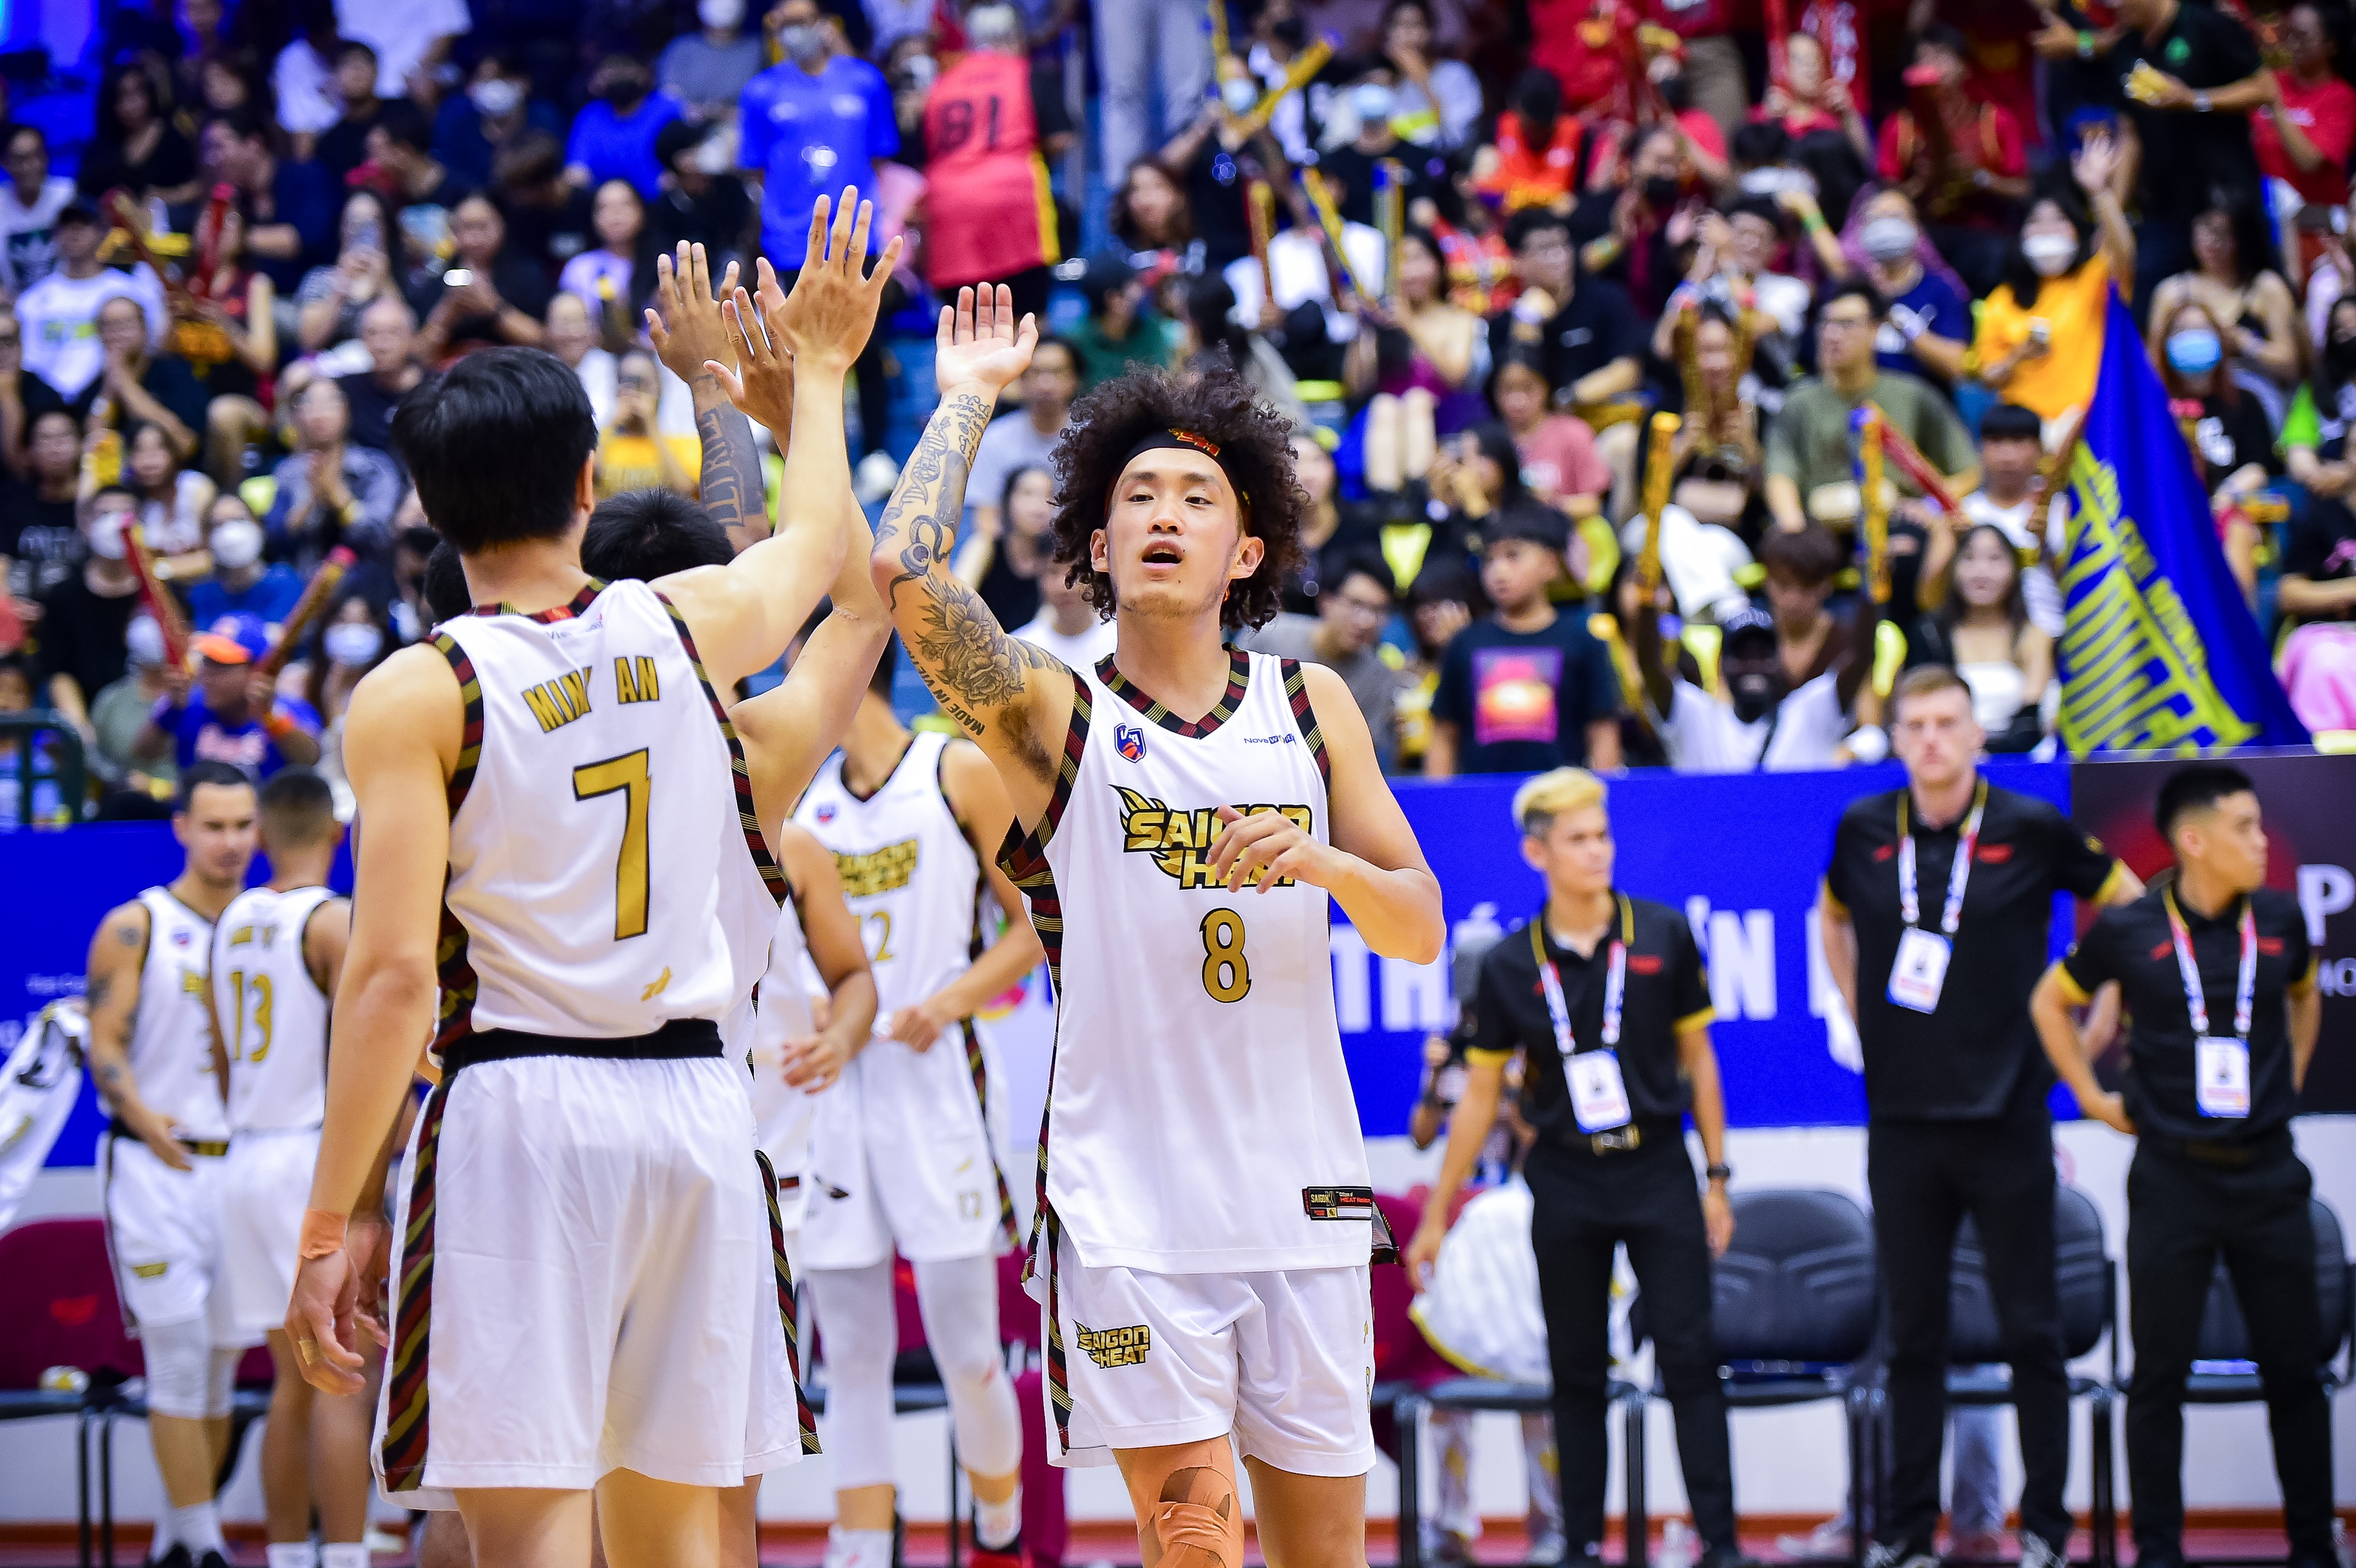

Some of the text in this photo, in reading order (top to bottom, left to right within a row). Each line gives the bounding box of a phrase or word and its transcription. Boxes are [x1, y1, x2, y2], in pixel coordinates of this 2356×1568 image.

[614, 656, 660, 704] AN
[933, 688, 951, 704] IN
[946, 703, 985, 736] MADE
[572, 747, 651, 941] 7
[854, 911, 894, 961] 2
[1199, 907, 1252, 1004] 8
[229, 970, 273, 1063] 13
[1077, 1325, 1150, 1351] SAIGON
[1098, 1343, 1149, 1369] HEAT
